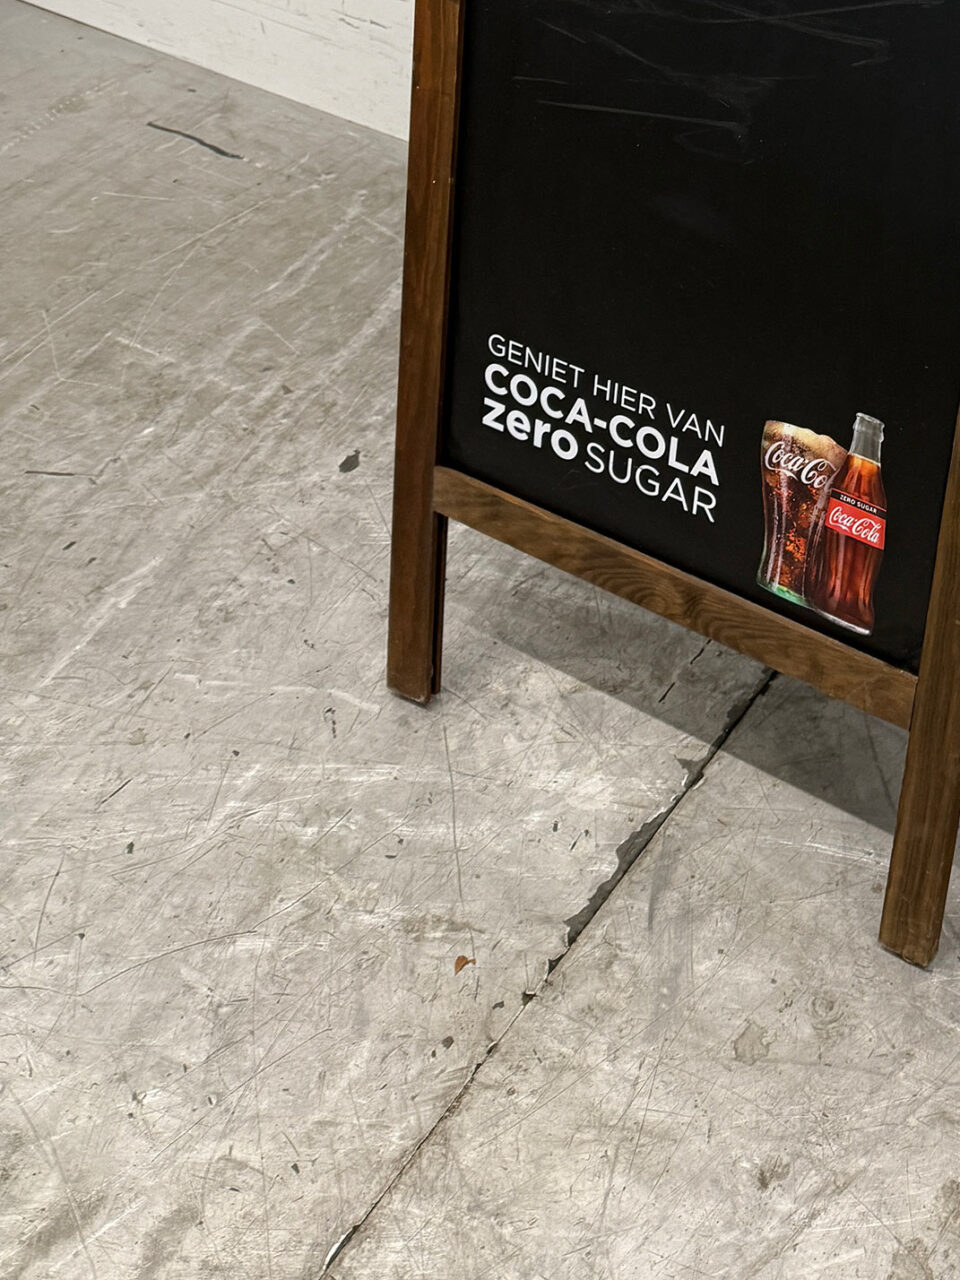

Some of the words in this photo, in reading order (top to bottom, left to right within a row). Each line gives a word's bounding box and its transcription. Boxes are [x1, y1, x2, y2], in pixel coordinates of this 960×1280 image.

[484, 363, 720, 486] COCA-COLA
[488, 333, 585, 389] GENIET
[593, 374, 657, 420] HIER
[666, 402, 725, 448] VAN
[481, 396, 579, 461] zero
[584, 442, 717, 523] SUGAR
[839, 494, 856, 505] ZERO
[856, 501, 877, 514] SUGAR
[828, 506, 882, 543] Coca-Cola
